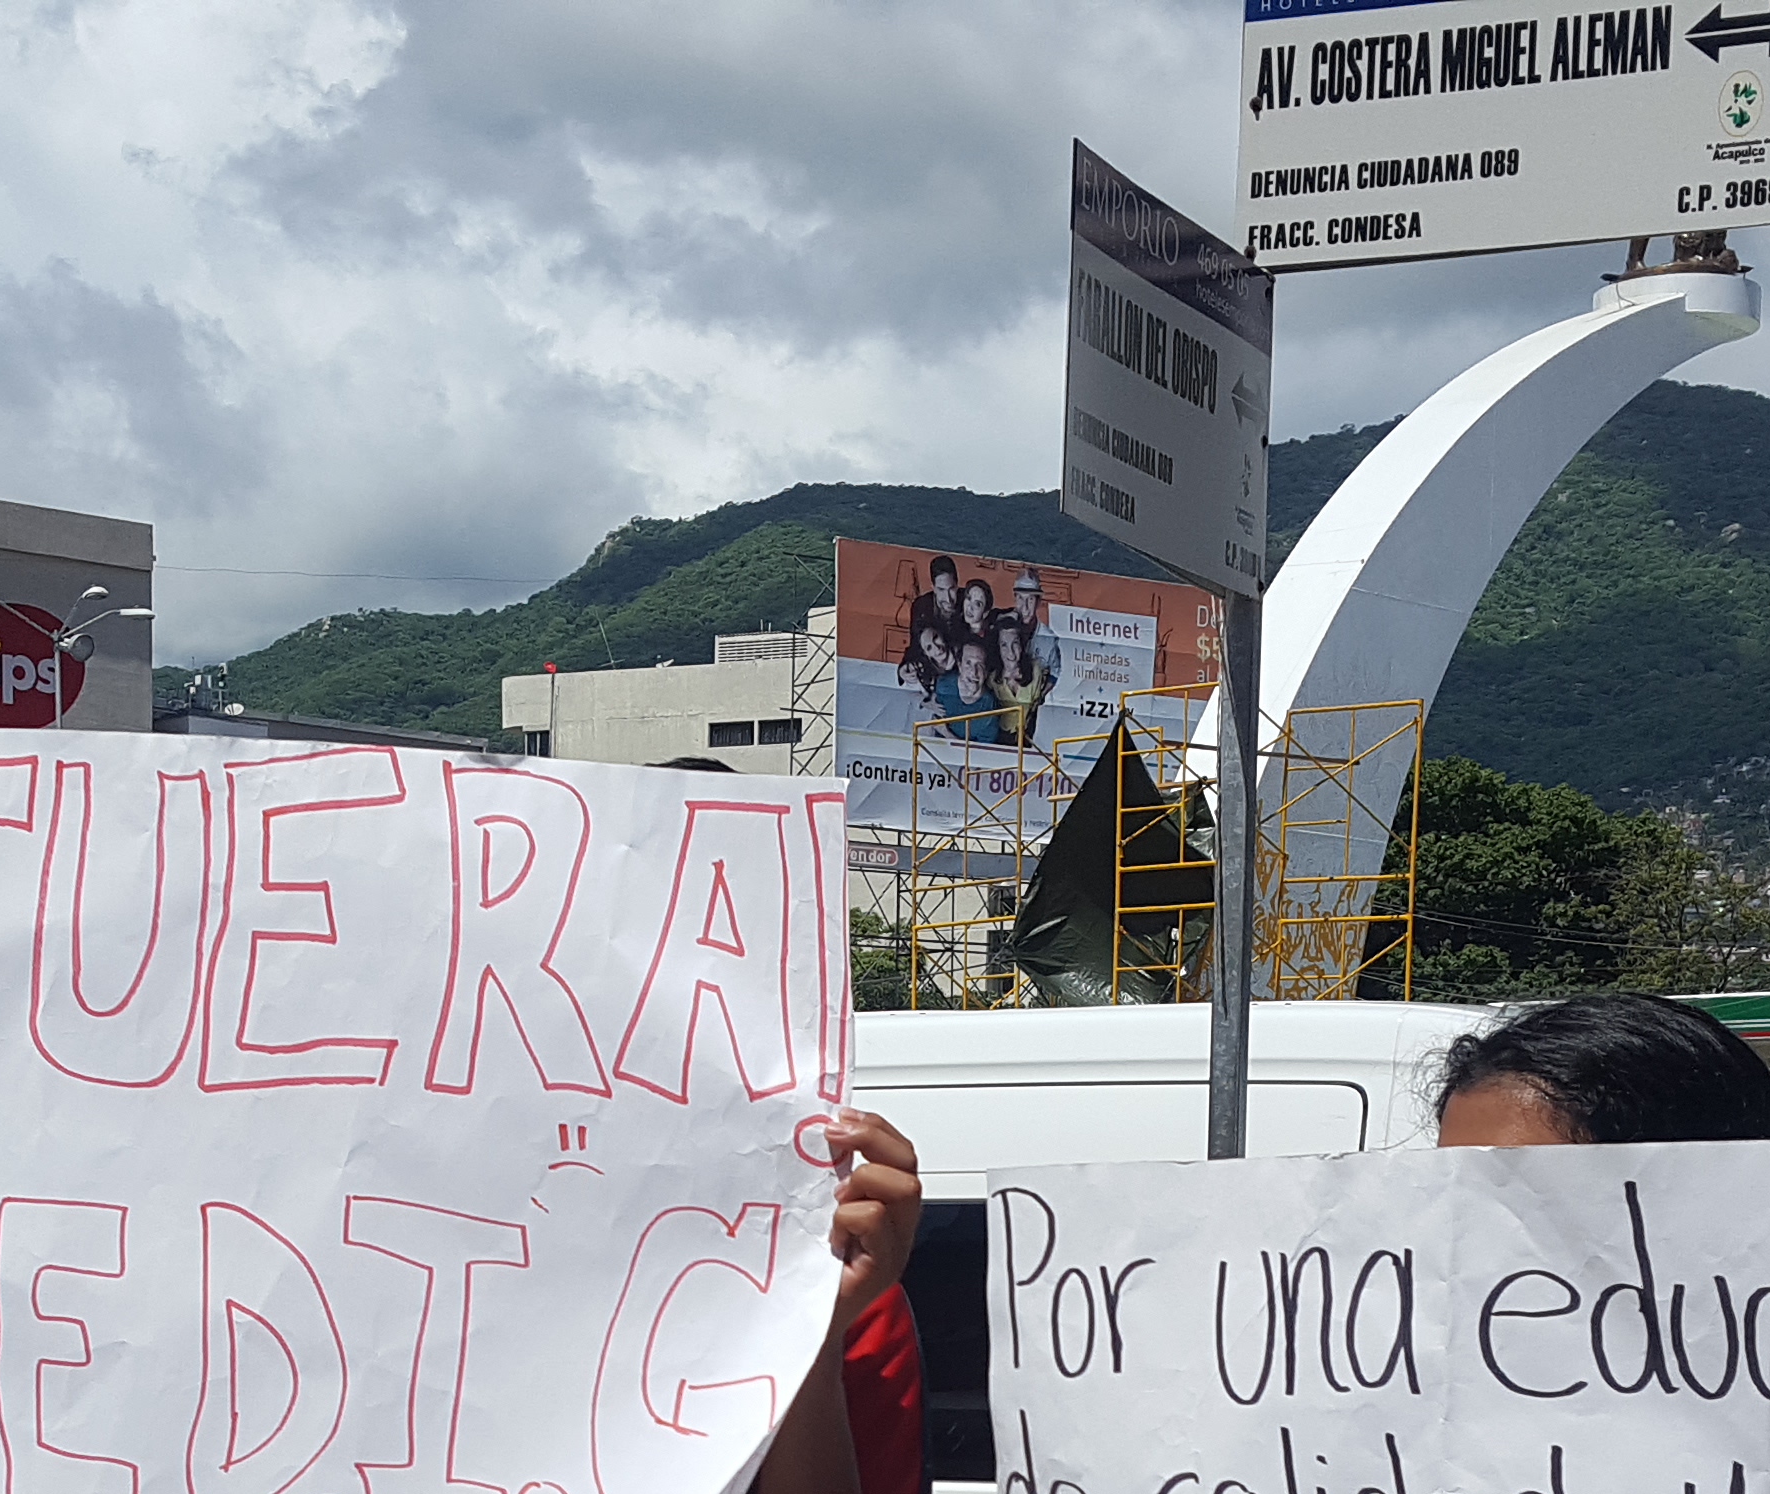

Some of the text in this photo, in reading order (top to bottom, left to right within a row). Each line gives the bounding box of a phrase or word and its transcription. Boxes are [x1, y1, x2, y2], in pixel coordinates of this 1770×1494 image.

[1256, 5, 1672, 110] AV. COSTERA MIGUEL ALEMAN
[1712, 146, 1765, 161] Acapulco
[1250, 148, 1520, 199] DENUNCIA CIUDADANA 089
[1081, 157, 1179, 266] EMPORIO
[1678, 184, 1718, 214] C.P.
[1248, 212, 1422, 250] FRACC. CONDESA
[1197, 243, 1219, 279] 469
[1221, 258, 1235, 290] 05
[1145, 311, 1168, 390] DEL
[1171, 328, 1218, 415] OBISPO
[1070, 612, 1139, 640] Internet
[1074, 647, 1130, 667] Llamadas
[1073, 665, 1130, 684] ilimitadas
[846, 760, 923, 785] ¡Contrata
[928, 771, 952, 791] ya!
[849, 849, 892, 864] endor
[992, 1187, 1156, 1379] Por
[1213, 1245, 1422, 1405] una
